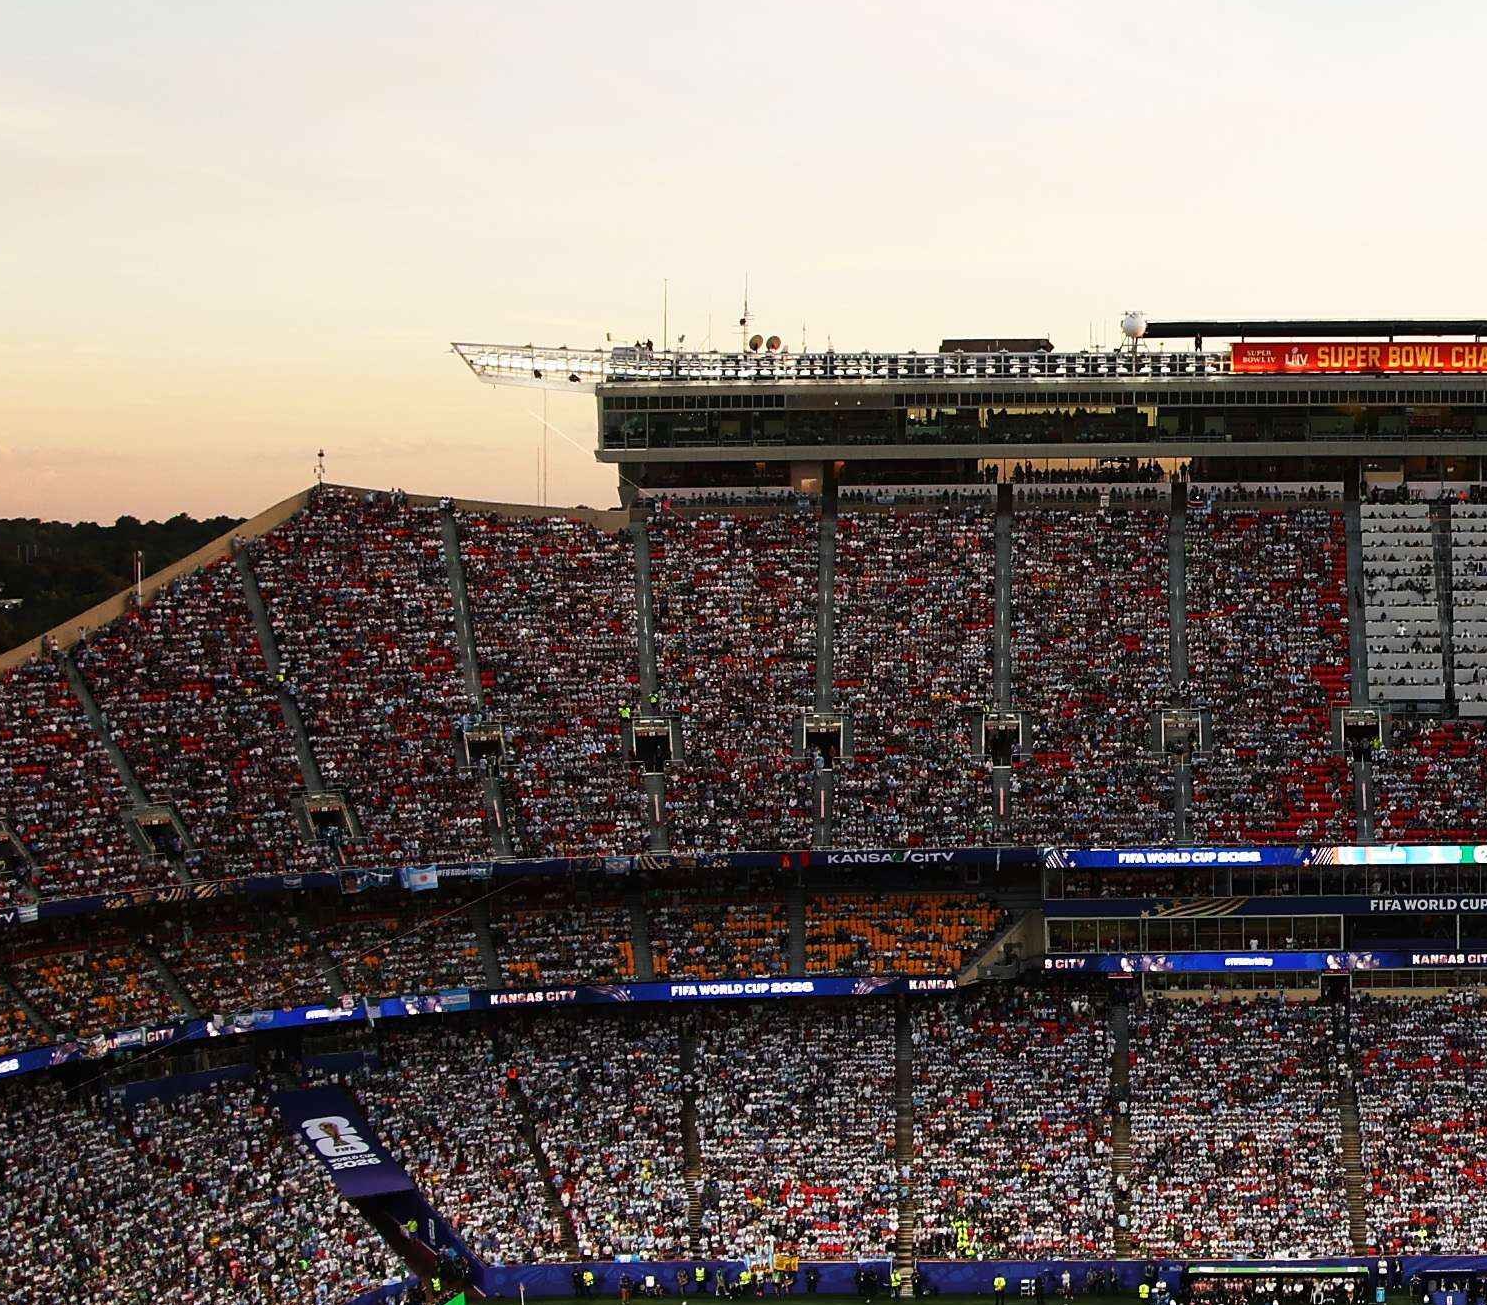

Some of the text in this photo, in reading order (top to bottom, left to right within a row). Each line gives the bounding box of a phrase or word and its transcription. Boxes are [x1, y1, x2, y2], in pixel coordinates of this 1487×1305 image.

[1317, 346, 1381, 368] SUPER
[1388, 346, 1444, 367] BOWL
[827, 852, 955, 864] KANSA CITY
[1118, 851, 1262, 865] FIFA WORLD CUP 2026
[1370, 899, 1402, 911] FIFA
[1403, 899, 1458, 911] WORLD
[1055, 958, 1087, 969] CITY
[1412, 954, 1465, 965] KANSAS
[670, 981, 815, 997] FIFA WORLD CUP 2026
[908, 979, 957, 991] KANSA
[490, 990, 578, 1005] KANSAS CITY
[145, 1028, 175, 1044] CITY
[327, 1152, 378, 1164] WORLD CUP
[331, 1157, 382, 1171] 2026
